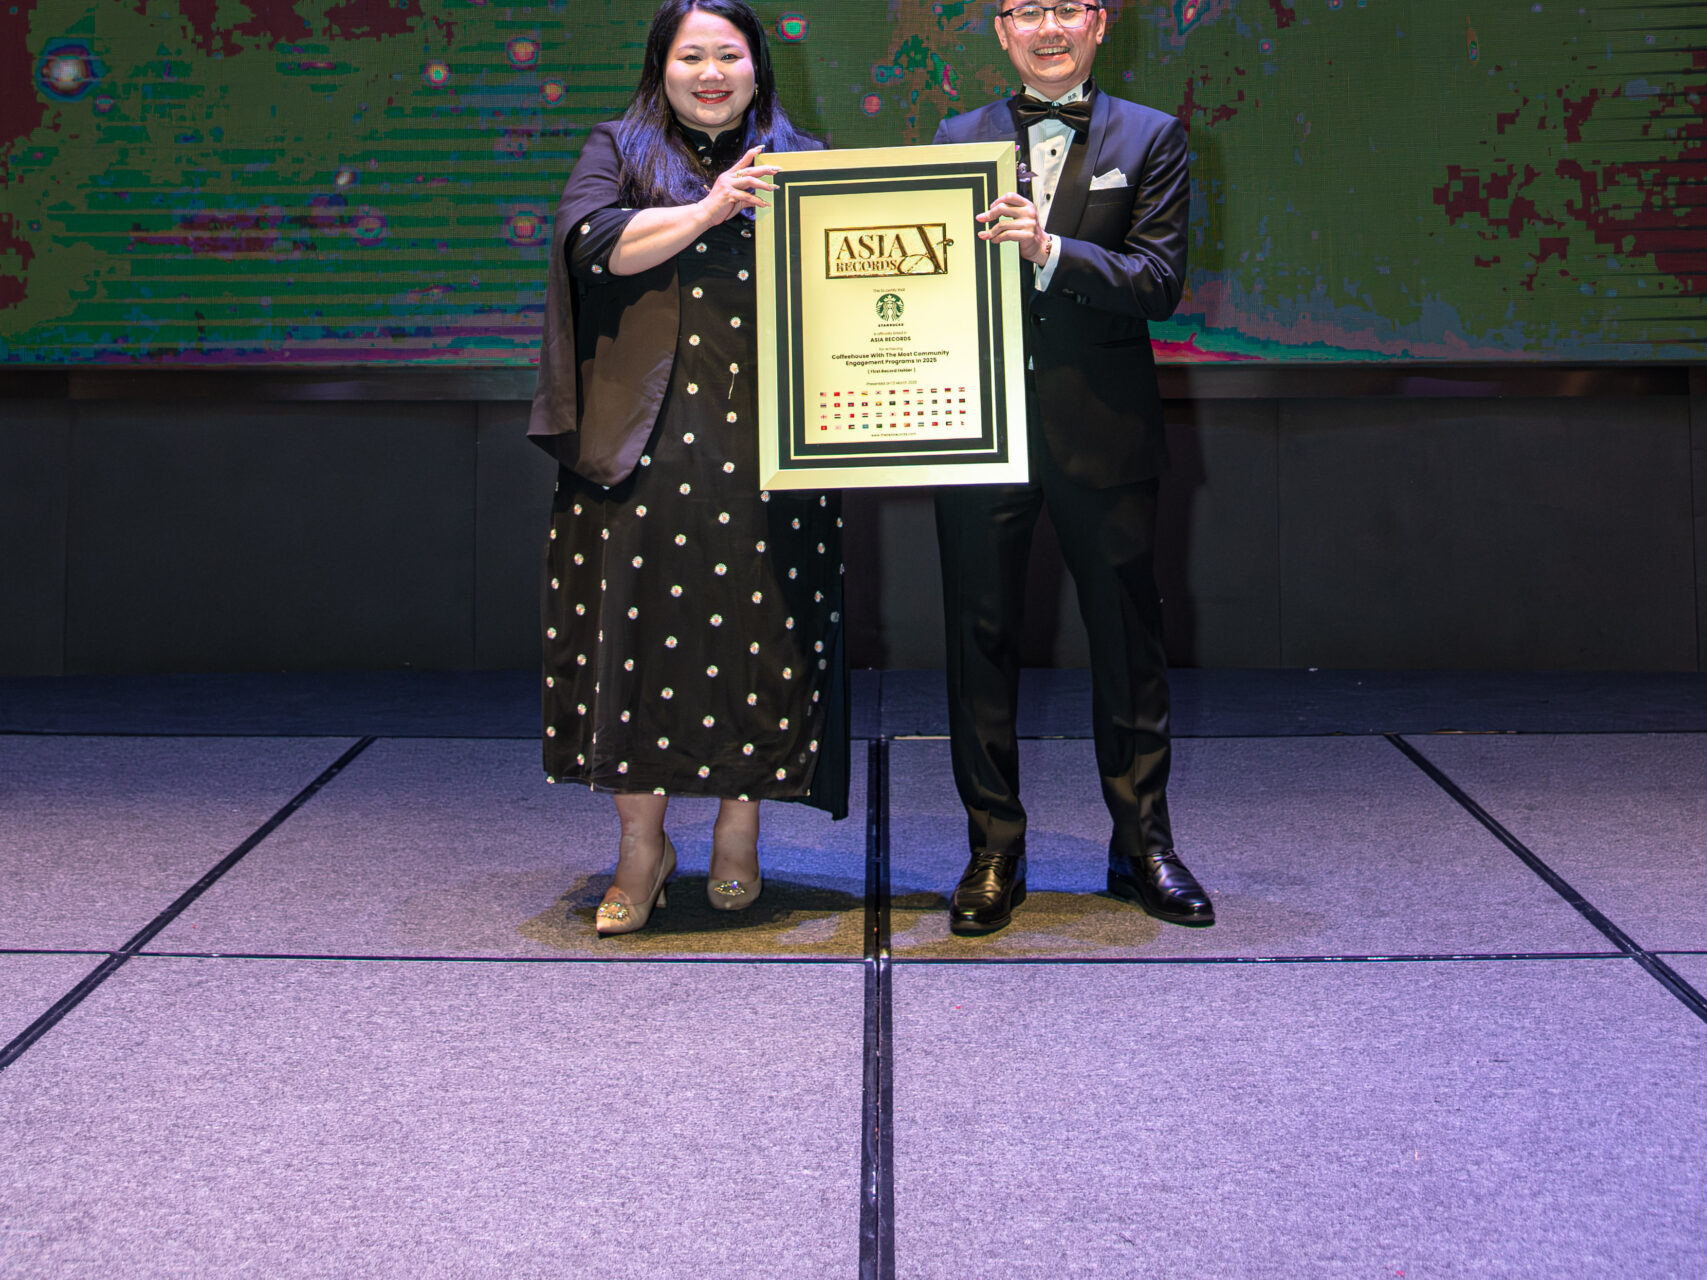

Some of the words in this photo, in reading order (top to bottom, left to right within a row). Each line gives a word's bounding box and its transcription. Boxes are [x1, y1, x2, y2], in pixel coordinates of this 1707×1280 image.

[835, 233, 908, 260] ASIA
[836, 260, 898, 273] RECORDS
[845, 359, 884, 367] Engagement
